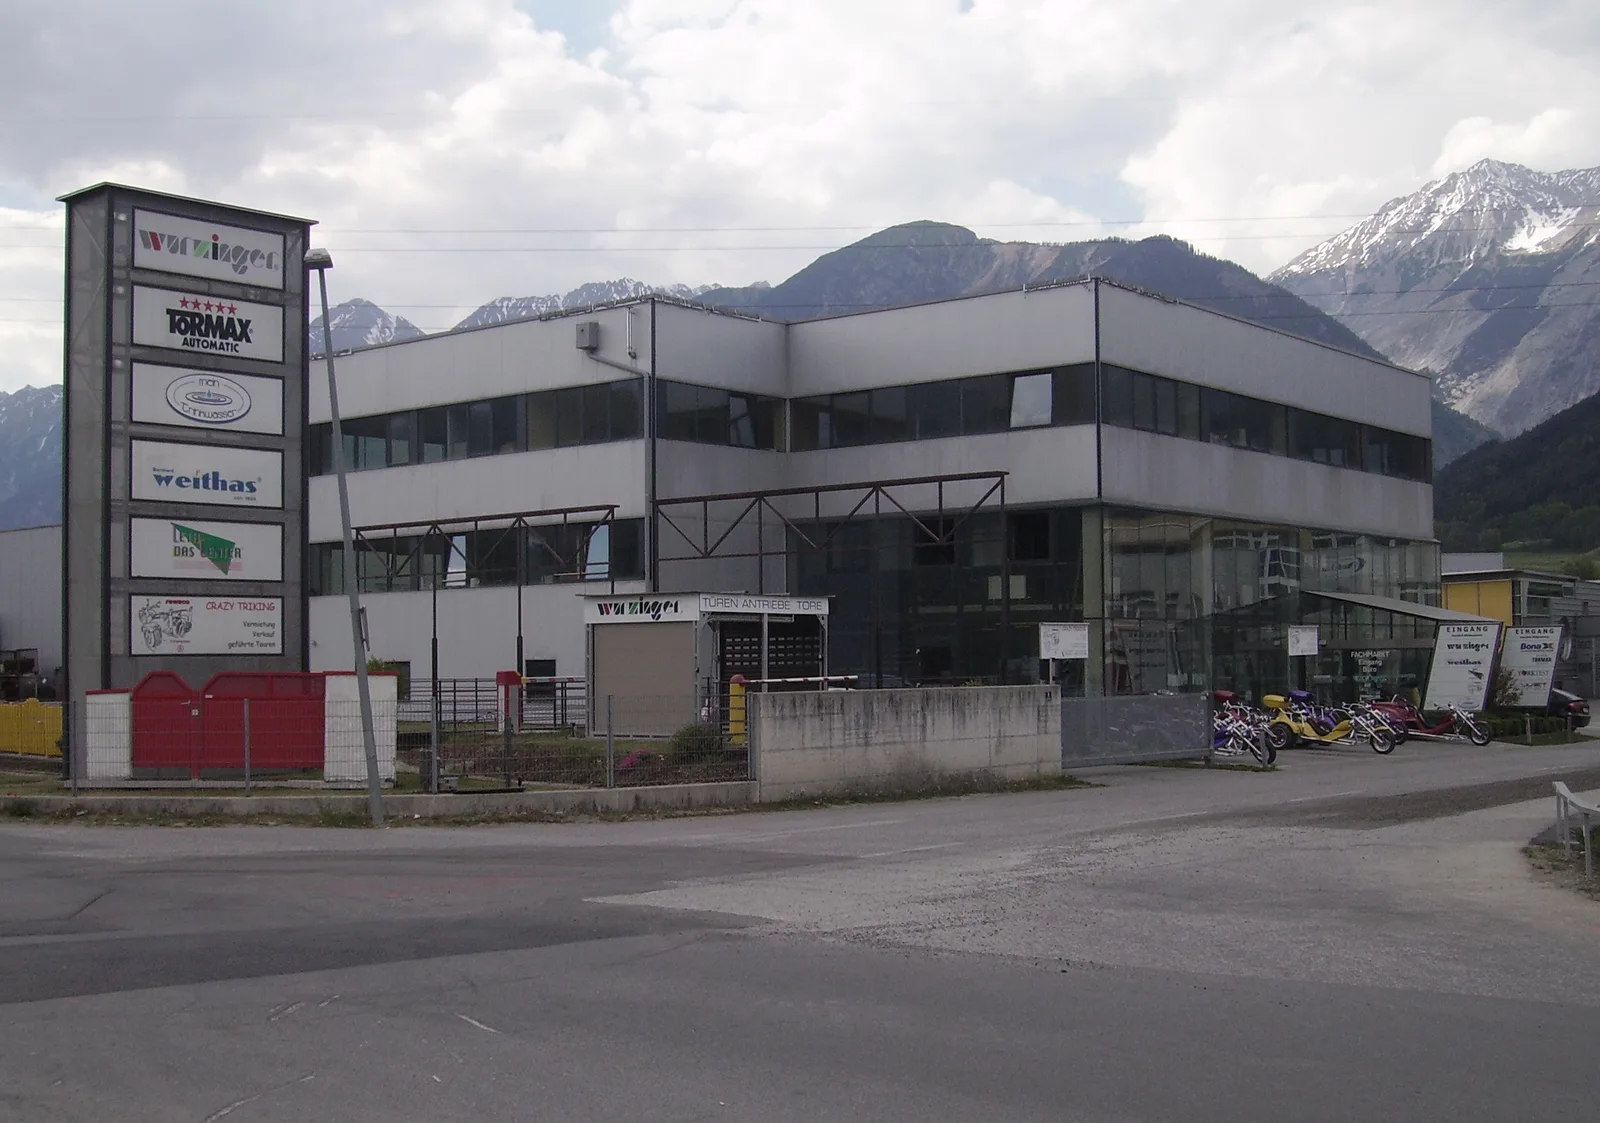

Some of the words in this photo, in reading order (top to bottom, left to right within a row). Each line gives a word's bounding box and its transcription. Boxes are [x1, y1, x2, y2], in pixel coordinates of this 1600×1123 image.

[139, 229, 278, 275] wurzinger
[166, 307, 252, 344] TORMAX
[182, 337, 240, 353] AUTOMATIC
[153, 470, 258, 494] weithas
[174, 545, 195, 557] DAS
[206, 601, 234, 611] CRAZY
[238, 602, 275, 611] TRIKING
[597, 596, 679, 622] wurzinger
[703, 595, 741, 609] TÜREN
[742, 598, 790, 610] ANTRIEBE
[796, 599, 823, 611] TORE
[252, 630, 275, 638] Verkauf
[1446, 625, 1489, 633] EINGANG
[1520, 642, 1542, 650] Bona
